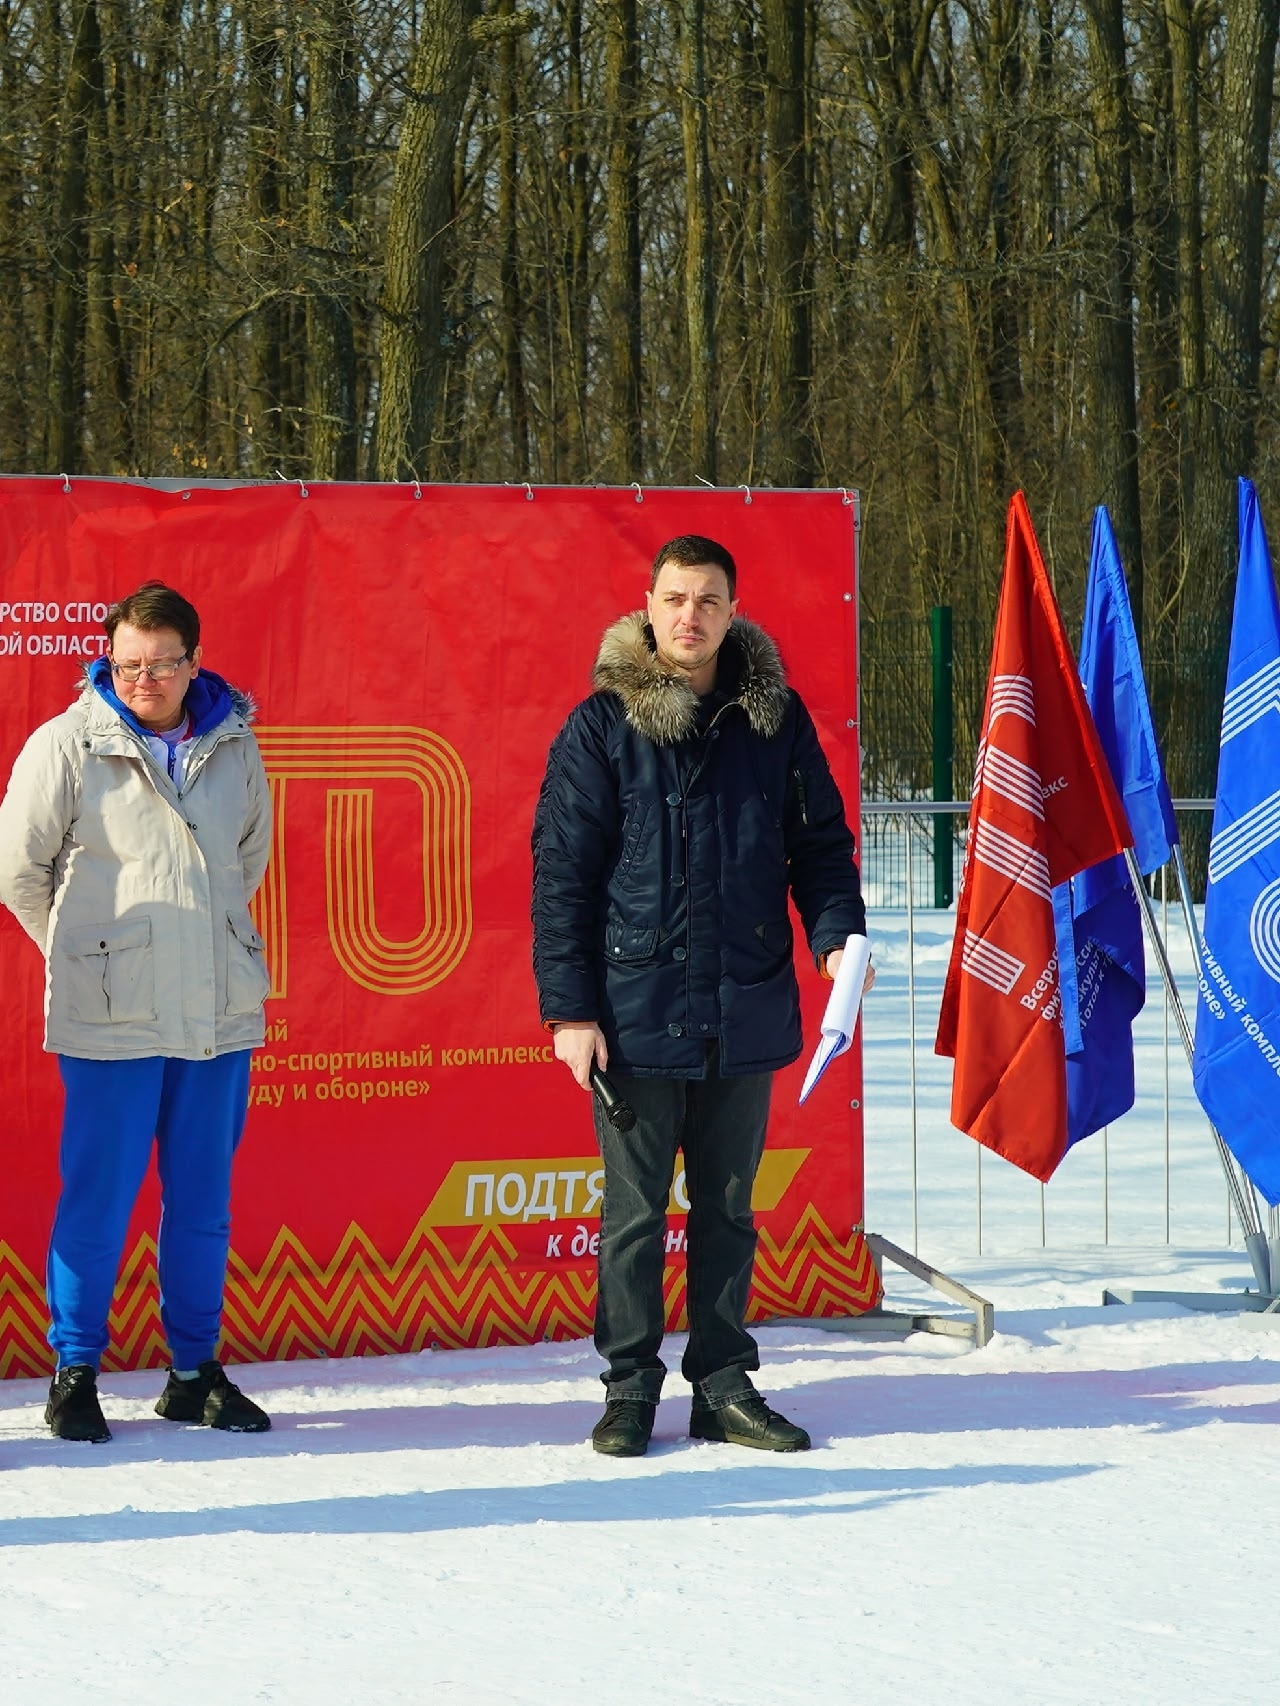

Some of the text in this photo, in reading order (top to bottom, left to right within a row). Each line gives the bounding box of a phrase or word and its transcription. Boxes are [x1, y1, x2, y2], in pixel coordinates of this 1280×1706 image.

[64, 602, 110, 622] СПО
[26, 635, 108, 655] ОБЛАСТ
[249, 1044, 554, 1075] но-спортивный комплекс
[293, 1083, 307, 1100] и
[315, 1078, 431, 1104] обороне»
